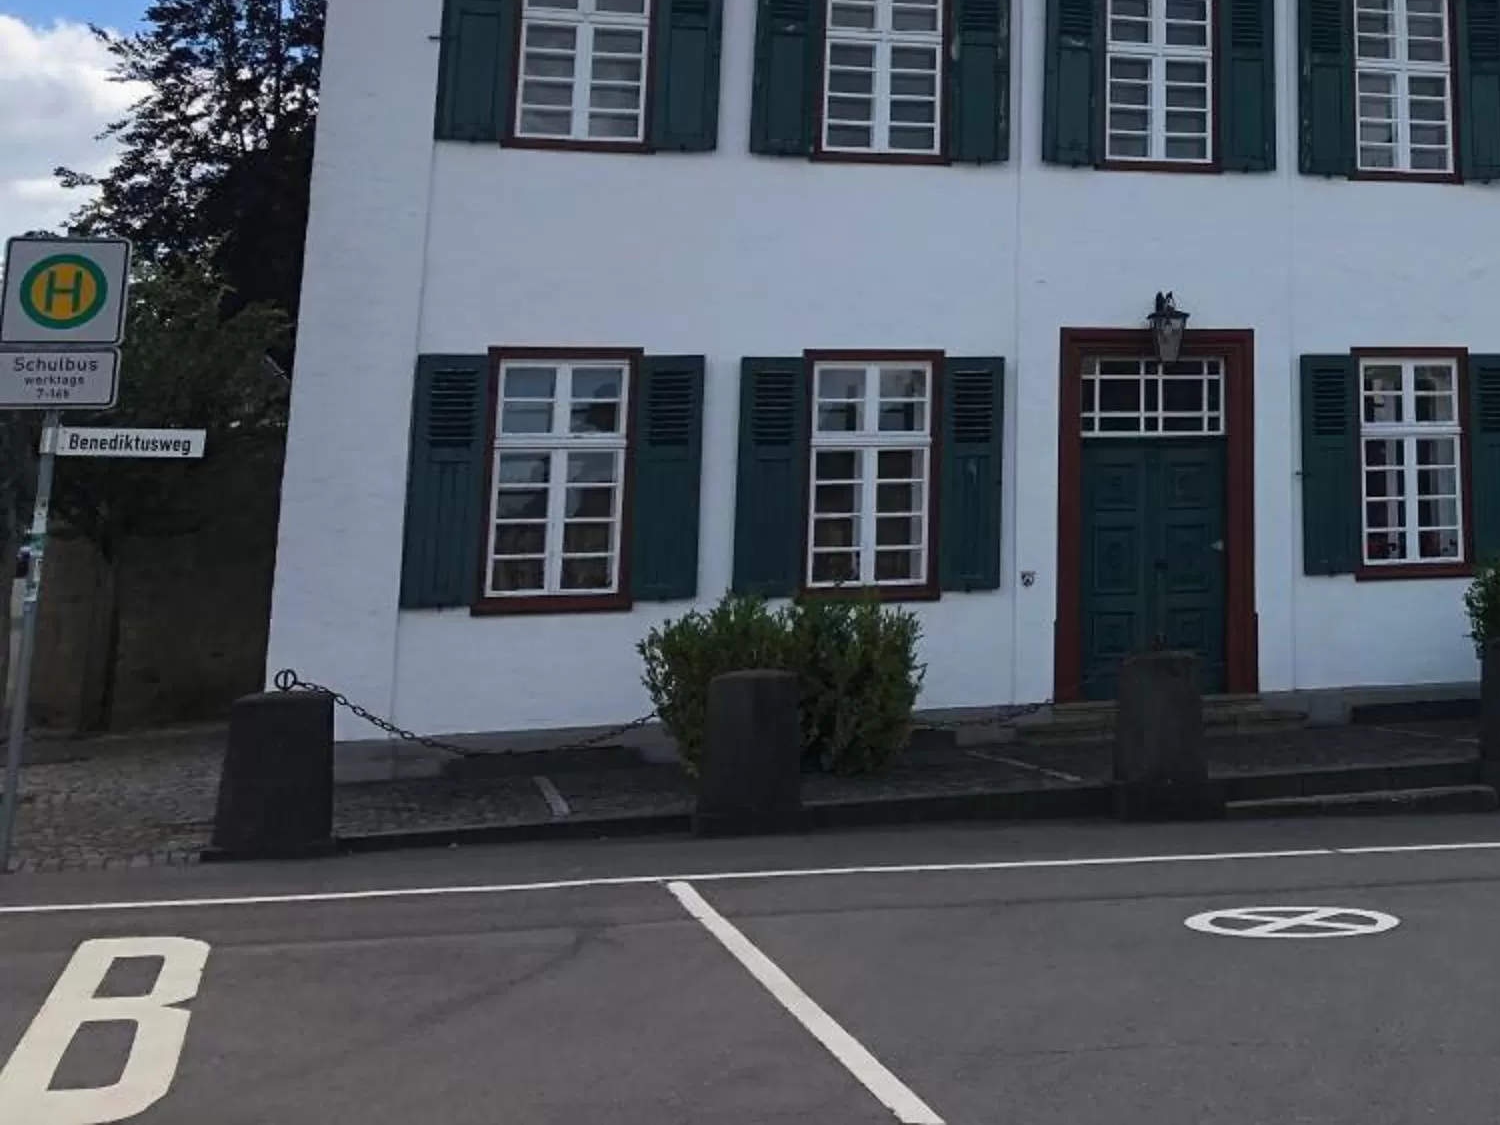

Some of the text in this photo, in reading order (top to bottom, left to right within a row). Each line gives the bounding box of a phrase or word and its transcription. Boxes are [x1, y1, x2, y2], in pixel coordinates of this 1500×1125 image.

[44, 270, 84, 313] H
[13, 356, 98, 372] Schulbus
[69, 433, 192, 454] Benediktusweg
